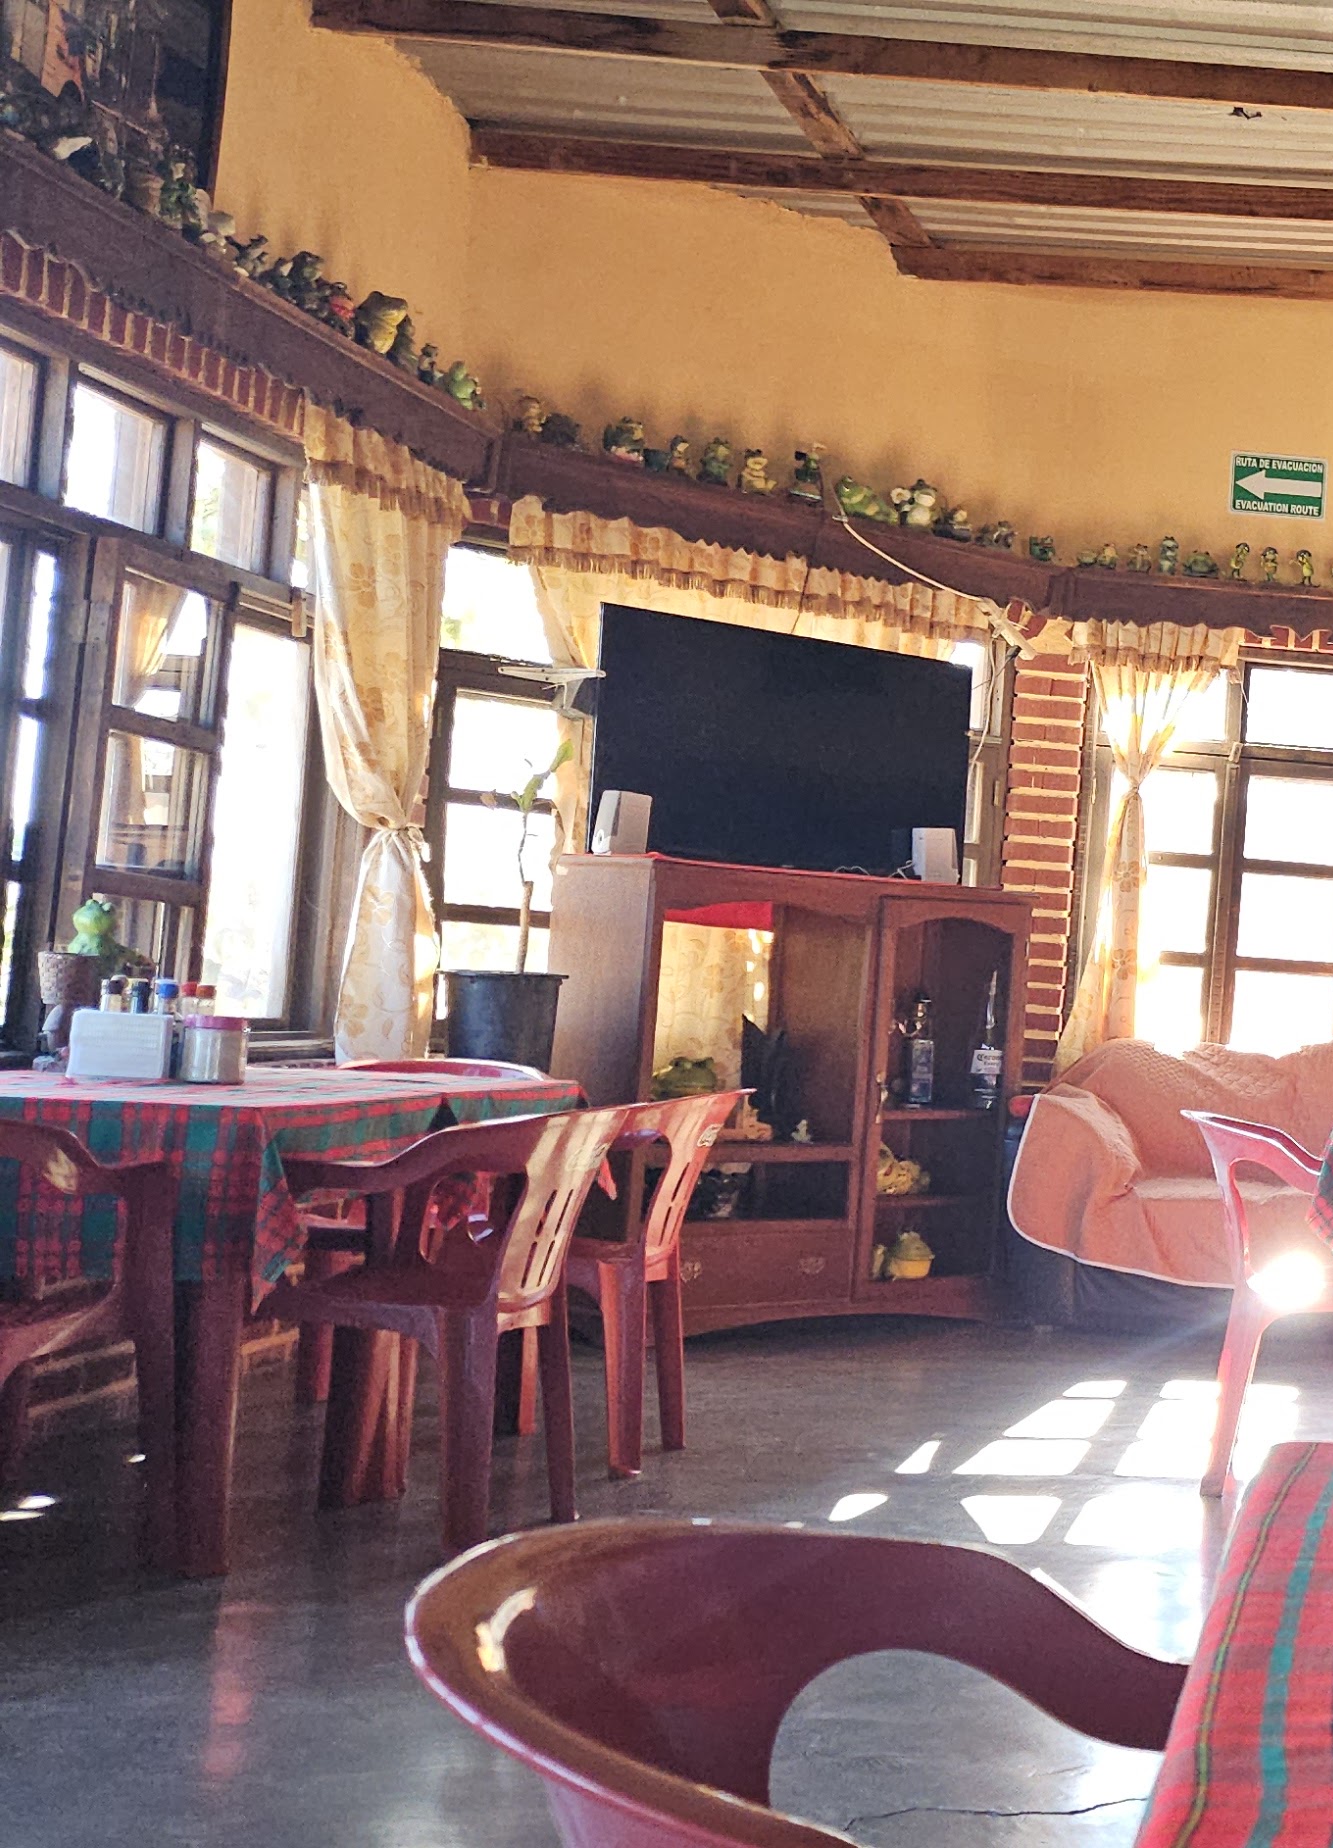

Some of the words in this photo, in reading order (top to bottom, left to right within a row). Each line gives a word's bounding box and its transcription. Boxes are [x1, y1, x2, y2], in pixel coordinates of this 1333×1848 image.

[1236, 457, 1257, 468] RUTA
[1259, 458, 1270, 469] DE
[1272, 460, 1323, 473] EVACUACION
[1235, 500, 1289, 513] EVACUATION
[1290, 504, 1320, 516] ROUTE
